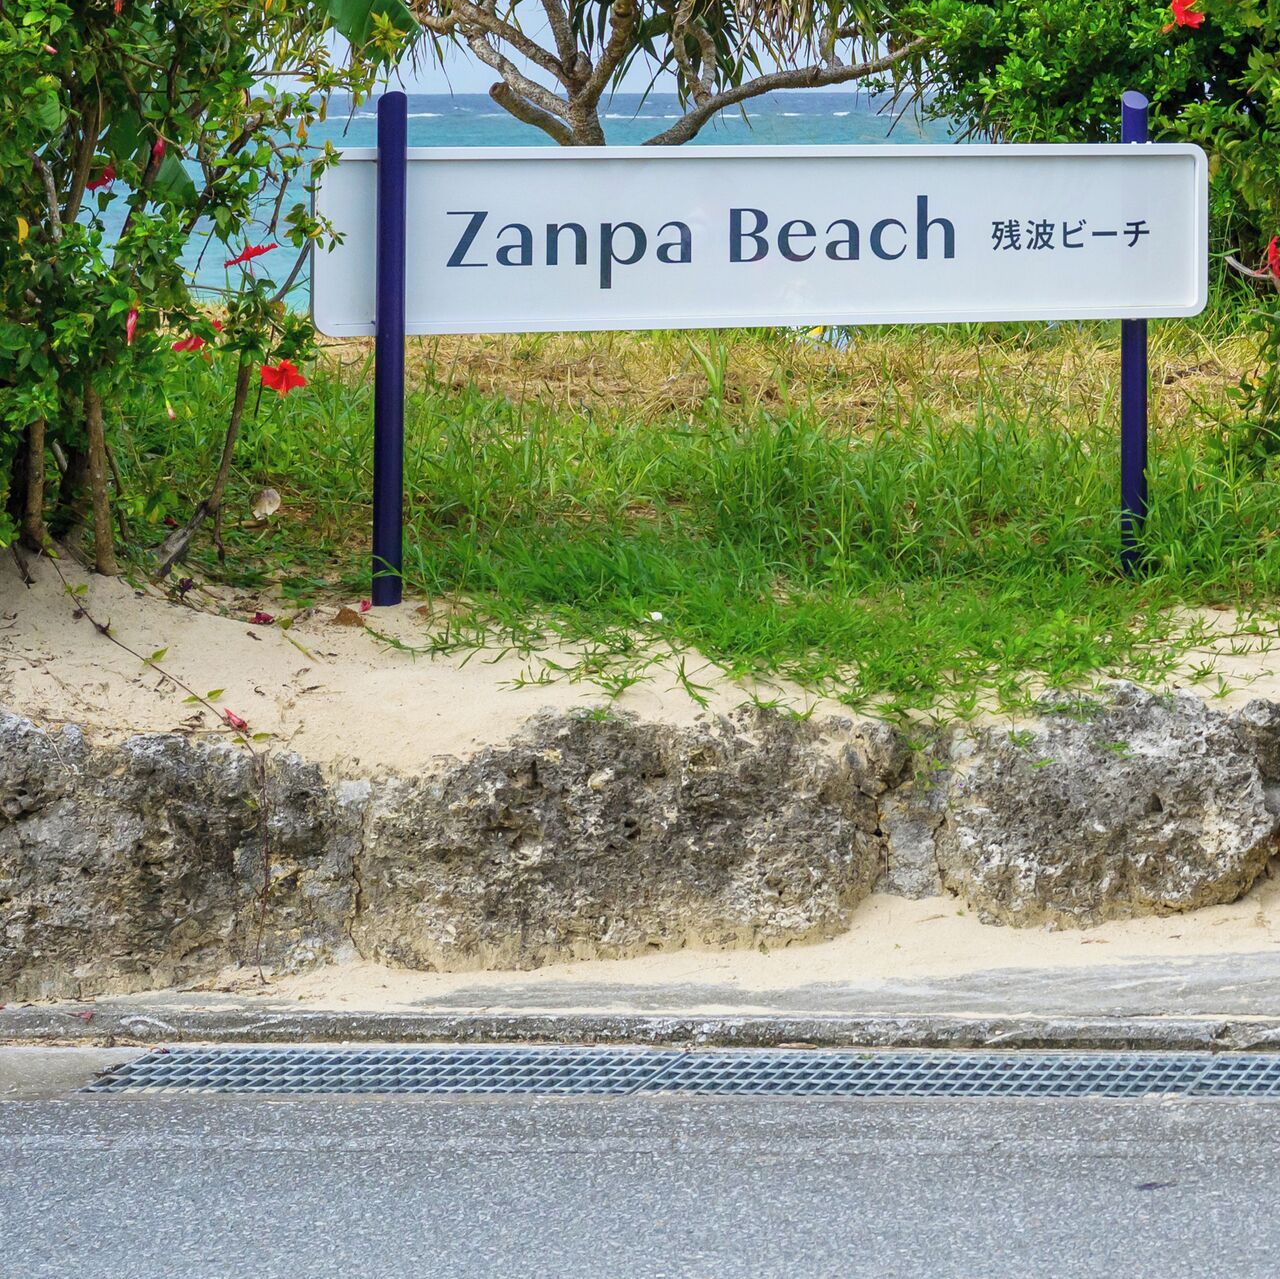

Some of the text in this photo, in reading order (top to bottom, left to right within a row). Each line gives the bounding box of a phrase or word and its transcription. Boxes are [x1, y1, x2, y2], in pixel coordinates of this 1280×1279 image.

[445, 194, 955, 290] Zanpa Beach
[991, 218, 1150, 251] 残波ビーチ
